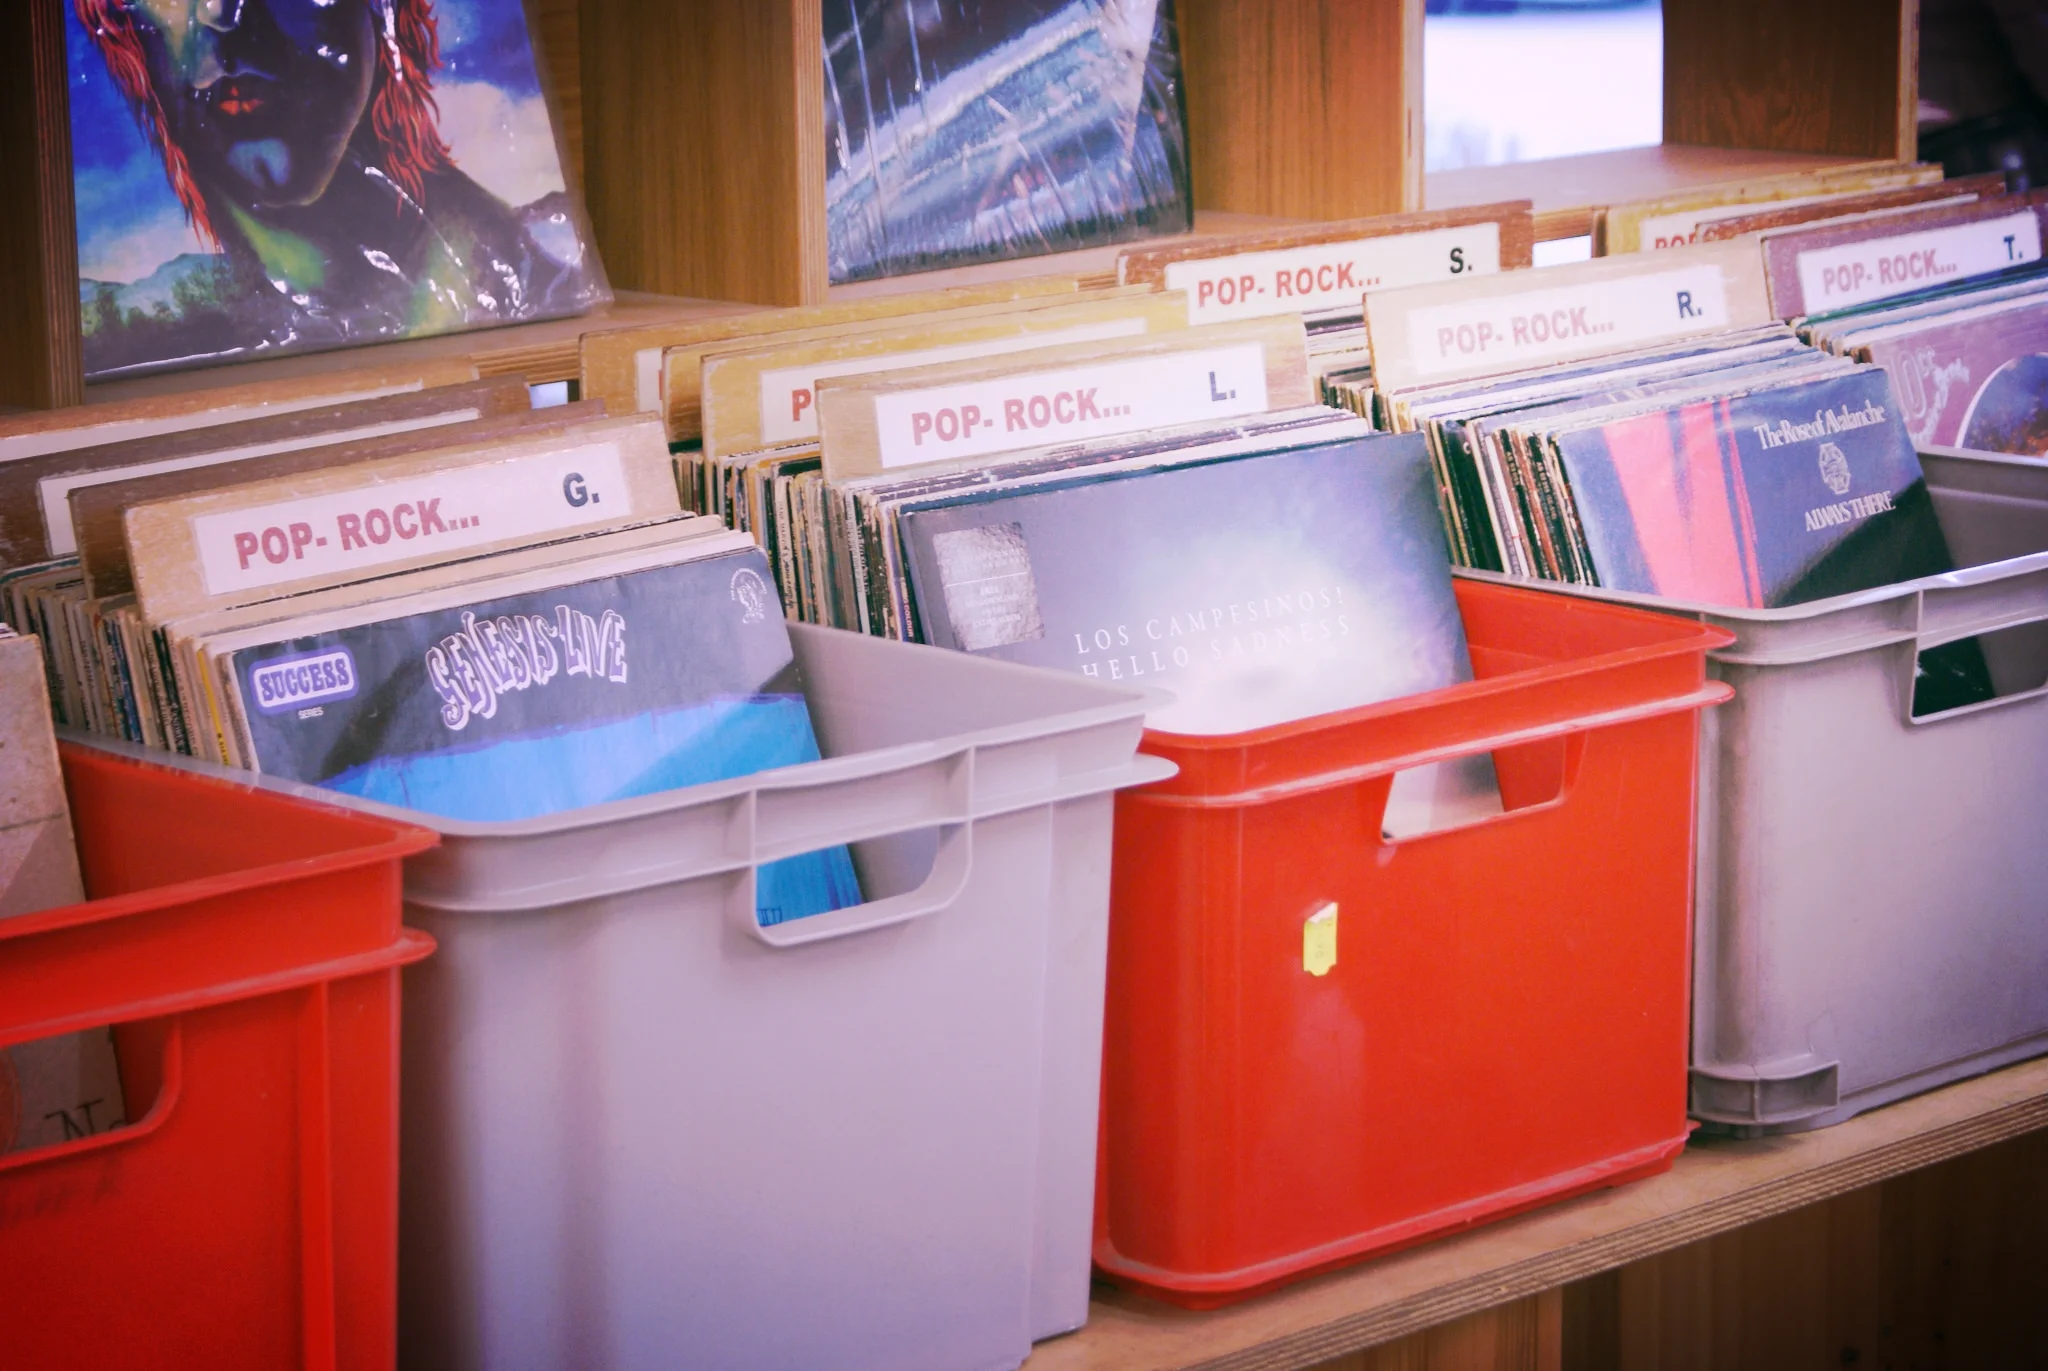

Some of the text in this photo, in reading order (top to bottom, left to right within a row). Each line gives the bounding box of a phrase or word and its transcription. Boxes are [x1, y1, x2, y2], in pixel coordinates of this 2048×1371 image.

[1198, 247, 1473, 308] POP- ROCK... S.
[1822, 261, 1873, 295] POP-
[2003, 234, 2023, 260] T.
[1437, 290, 1703, 358] POP- ROCK... R.
[911, 371, 1237, 446] POP- ROCK... L.
[1825, 399, 1886, 434] Avalanche
[234, 472, 601, 570] POP- ROCK... G.
[1074, 586, 1343, 654] LOS CAMPESINOS!
[1081, 614, 1350, 681] HELLO SADNESS
[258, 656, 350, 702] SUCCESS
[425, 604, 628, 731] GENESIS LIVE
